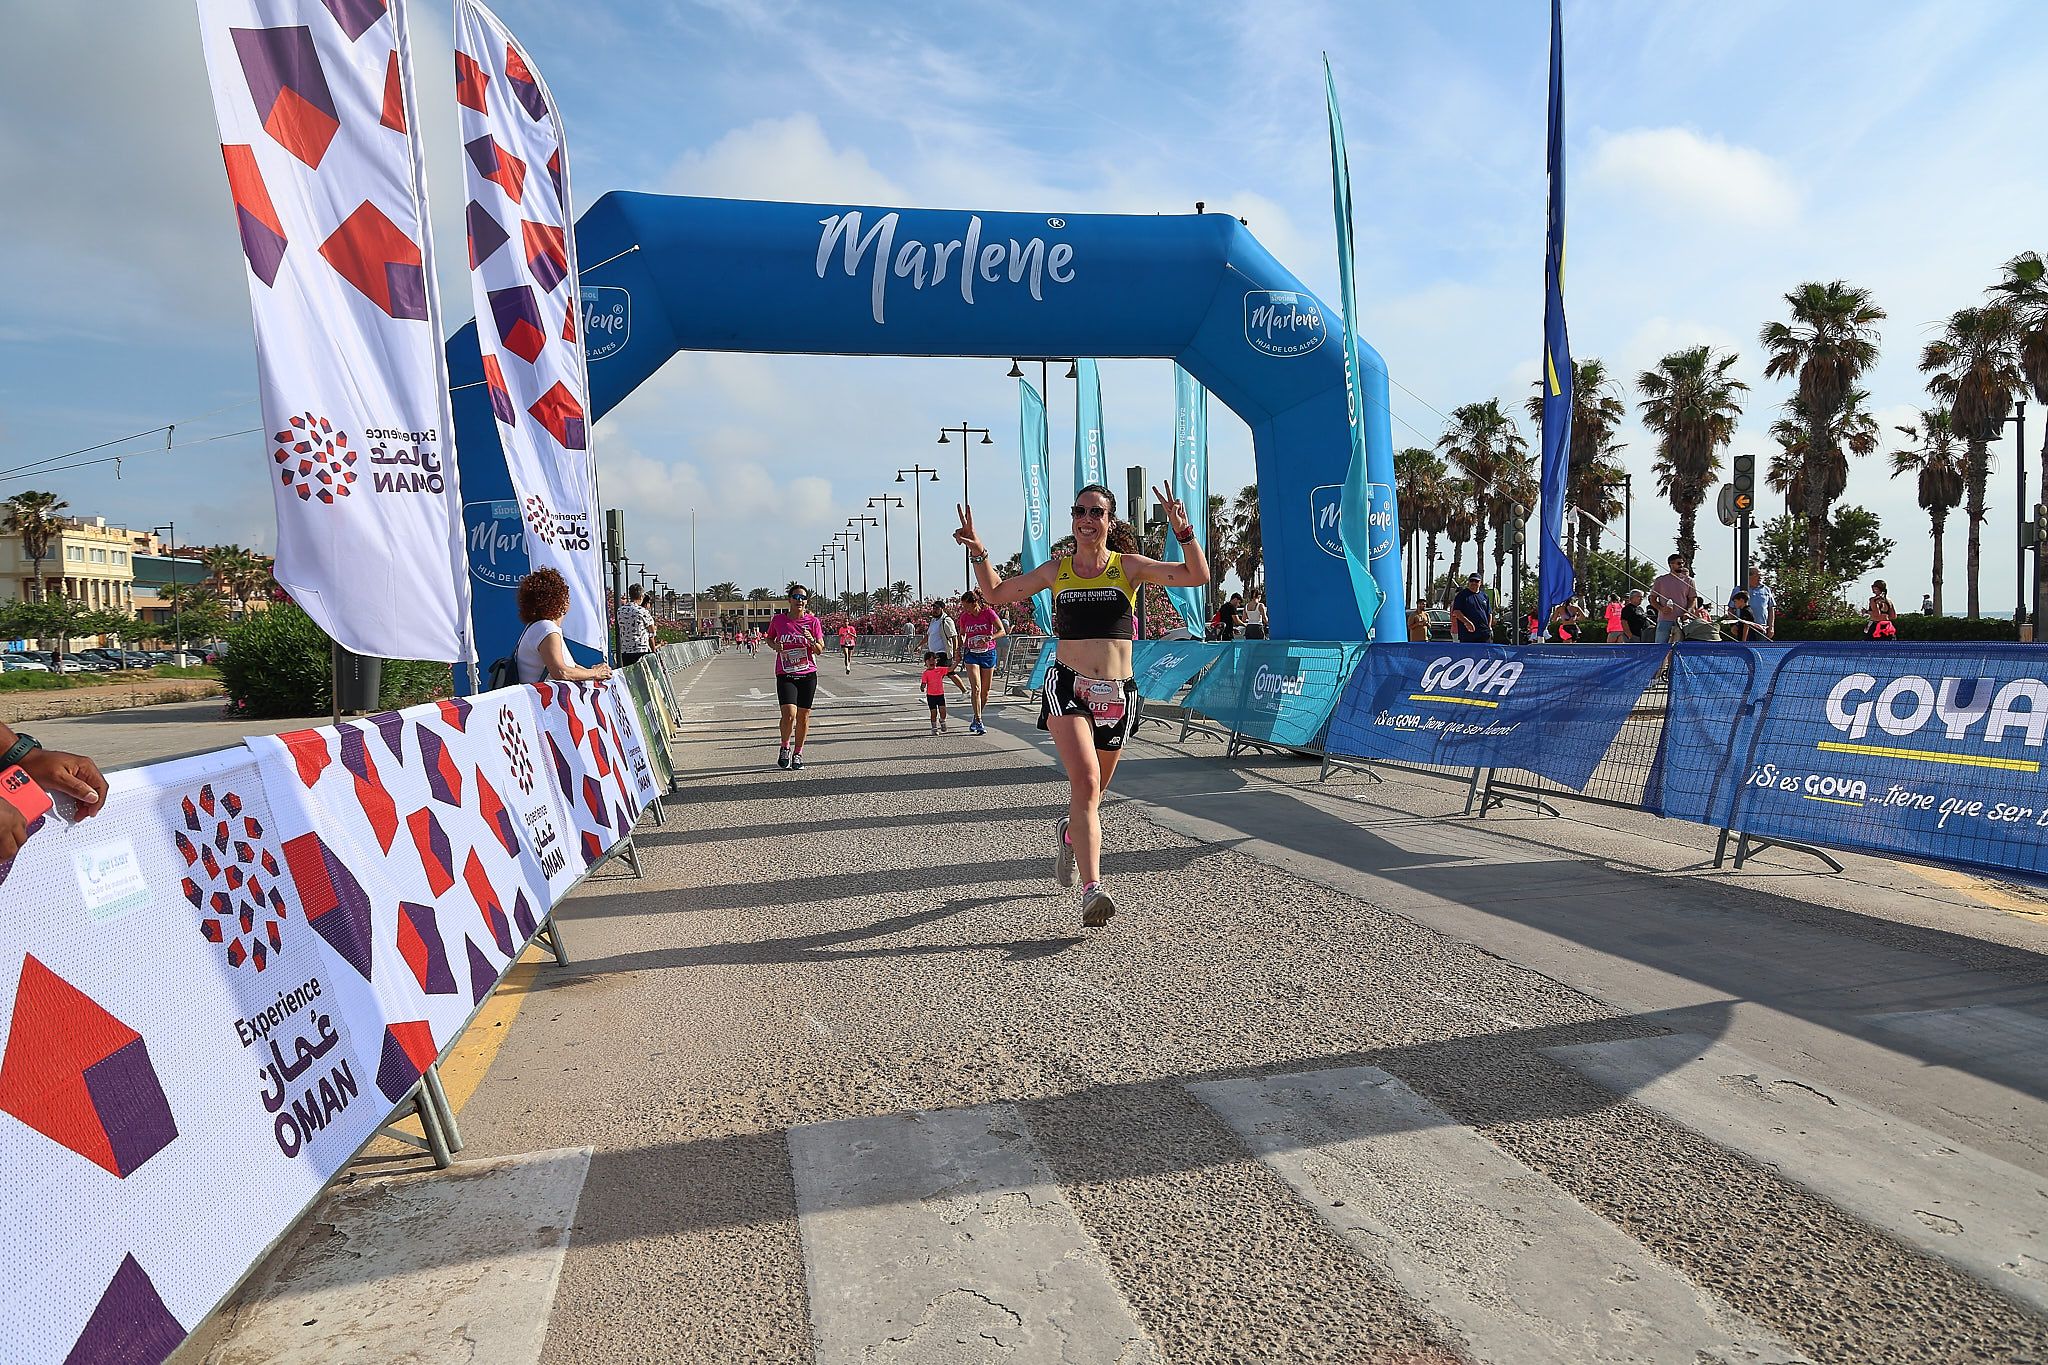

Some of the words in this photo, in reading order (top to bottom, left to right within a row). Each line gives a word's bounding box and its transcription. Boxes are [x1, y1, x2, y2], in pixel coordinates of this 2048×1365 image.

[816, 211, 1075, 324] Marlene
[584, 303, 623, 334] lene
[1251, 305, 1320, 339] Marlene
[593, 341, 616, 356] ALPES
[1256, 338, 1270, 350] HIJA
[1284, 345, 1298, 353] LOS
[1299, 336, 1318, 351] ALPES
[1325, 539, 1343, 553] HIJA
[1373, 539, 1390, 555] ALPES
[477, 564, 496, 579] HIJA
[498, 573, 512, 582] DE
[1088, 590, 1117, 598] RUNNERS
[1253, 664, 1306, 700] Compeed
[1420, 656, 1524, 696] GOYA
[1826, 673, 2048, 746] GOYA
[1395, 714, 1420, 728] GOYA
[1440, 722, 1464, 740] que
[1463, 724, 1484, 735] ser
[1780, 776, 1802, 792] es
[1804, 774, 1867, 800] GOYA
[1938, 797, 1982, 829] que
[1987, 802, 2033, 823] ser
[541, 846, 566, 882] OMAN
[234, 977, 322, 1048] Experience
[274, 1058, 359, 1159] OMAN
